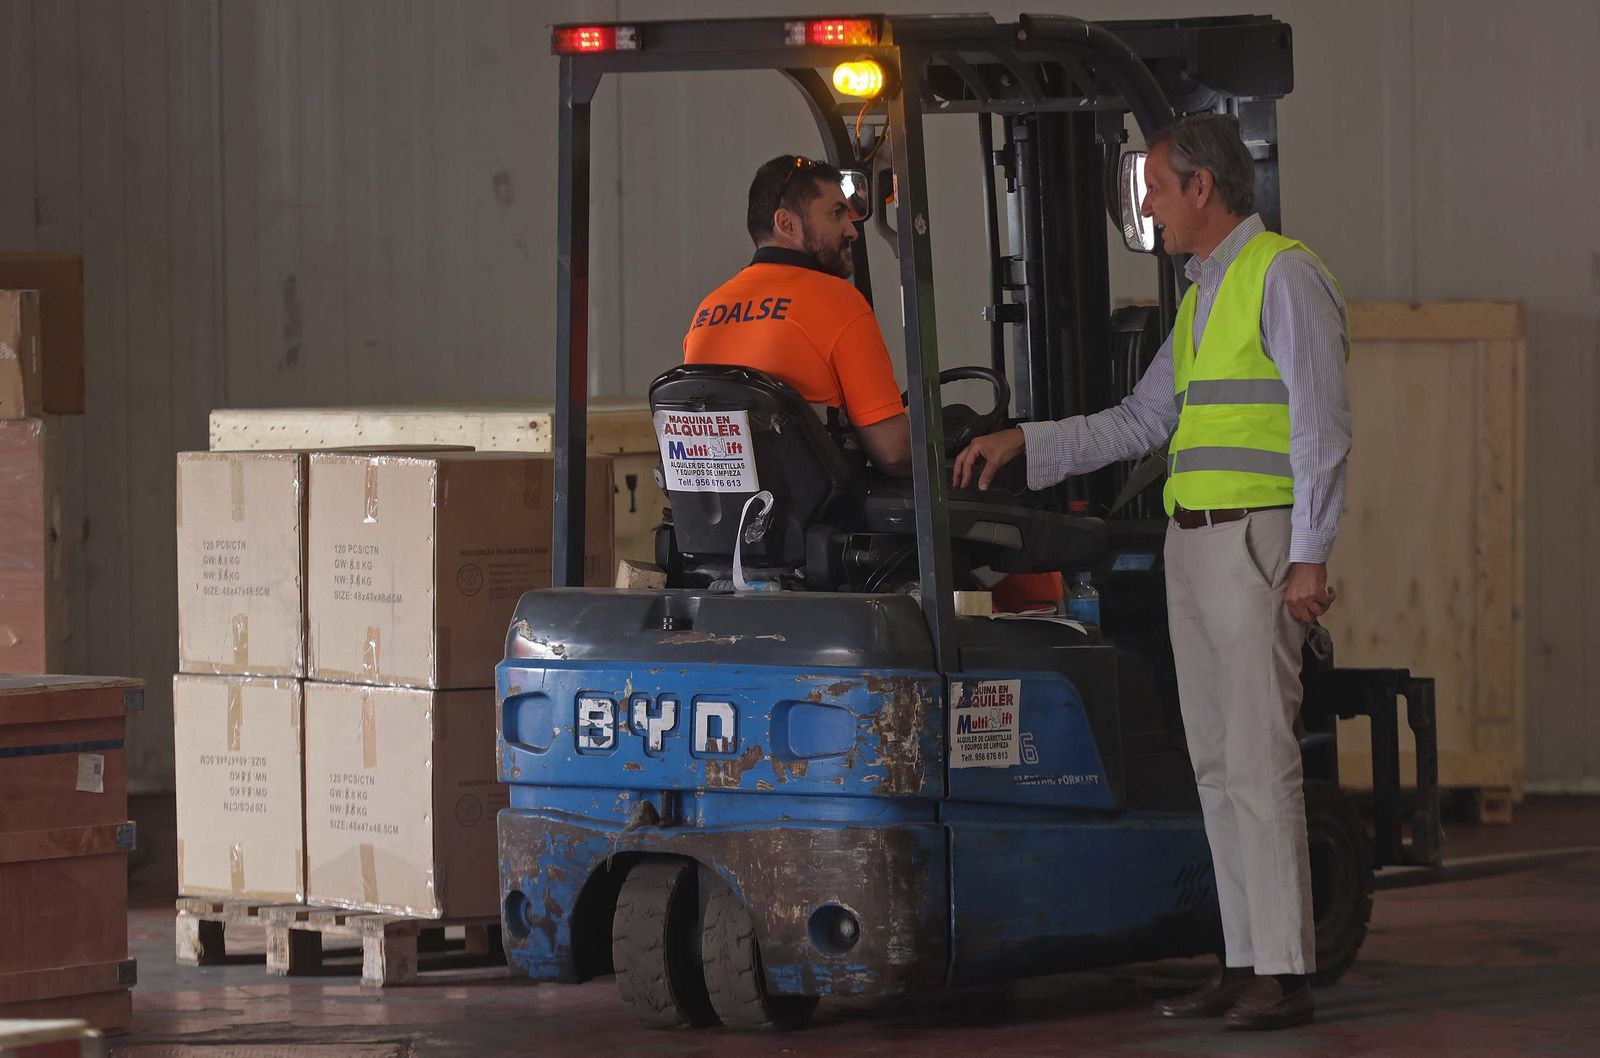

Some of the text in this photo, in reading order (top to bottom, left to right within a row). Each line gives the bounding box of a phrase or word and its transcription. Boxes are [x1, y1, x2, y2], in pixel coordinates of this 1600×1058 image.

[709, 297, 792, 327] DALSE
[668, 415, 730, 424] MAQUINA EN
[664, 424, 742, 436] ALQUILER
[706, 462, 745, 470] CARRETILLAS
[678, 479, 694, 487] Telf.
[696, 479, 710, 487] 956
[726, 479, 741, 487] 613
[334, 544, 379, 555] 120 PCS/CTN
[362, 560, 373, 570] KG
[362, 575, 372, 586] KG
[998, 685, 1008, 693] EN
[576, 695, 737, 754] BYD
[957, 735, 977, 744] ALQUILER
[984, 734, 1012, 742] CARRETILLAS
[964, 743, 983, 751] EQUIPOS
[983, 742, 989, 750] DE
[975, 753, 985, 761] 956
[998, 752, 1008, 760] 613
[329, 773, 342, 784] 120
[357, 790, 368, 800] KG
